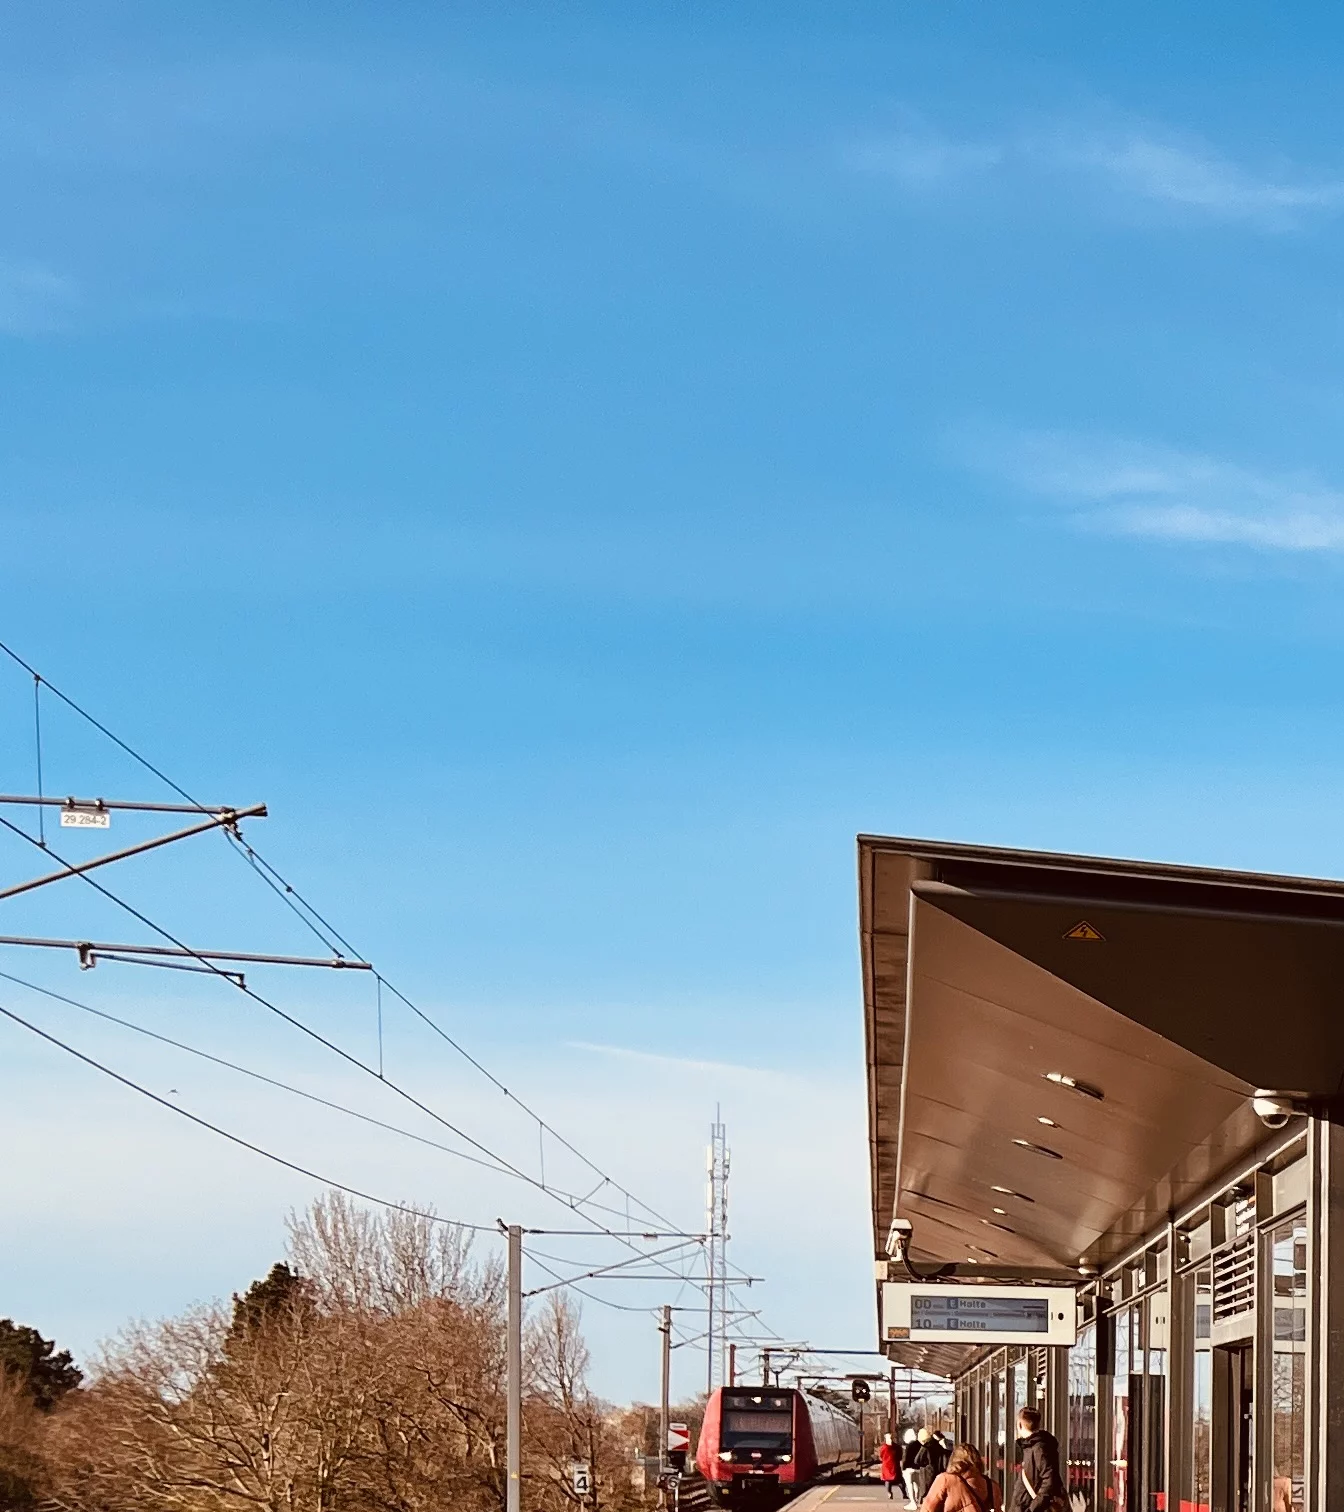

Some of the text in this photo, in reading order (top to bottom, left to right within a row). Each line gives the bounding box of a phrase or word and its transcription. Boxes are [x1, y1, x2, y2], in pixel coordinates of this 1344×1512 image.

[960, 1299, 986, 1309] Holte
[915, 1318, 932, 1329] 10
[960, 1320, 986, 1329] Holte
[577, 1476, 588, 1490] 4
